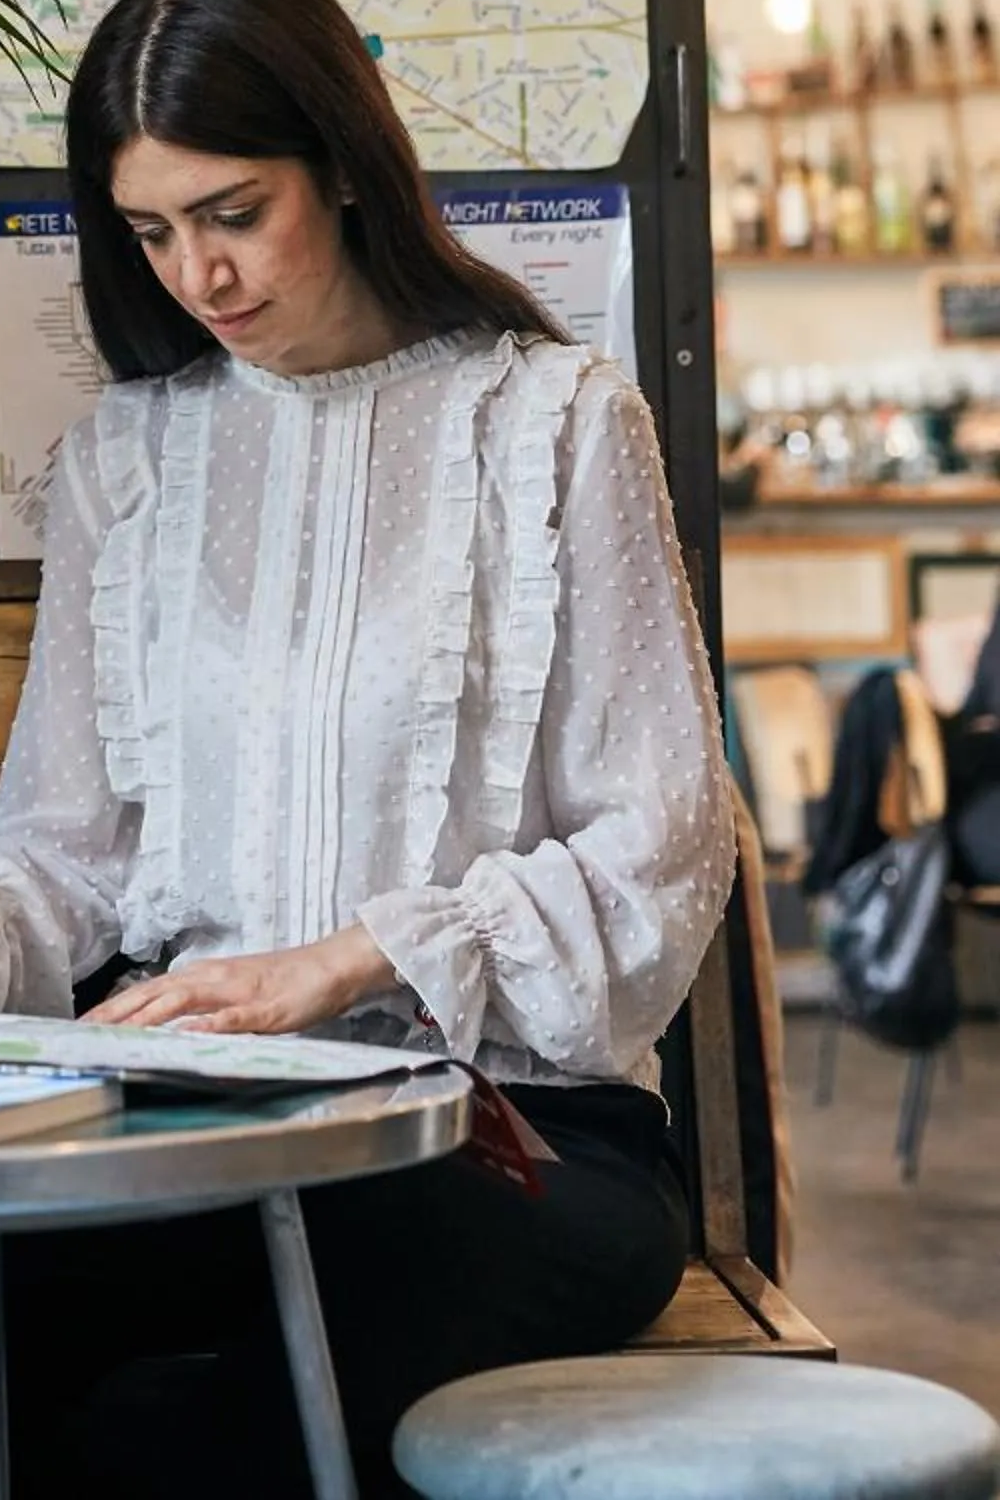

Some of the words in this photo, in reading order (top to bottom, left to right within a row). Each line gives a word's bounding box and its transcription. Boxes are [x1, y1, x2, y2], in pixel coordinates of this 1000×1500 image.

[442, 201, 500, 222] NIGHT
[510, 227, 556, 244] Every
[561, 226, 604, 243] night
